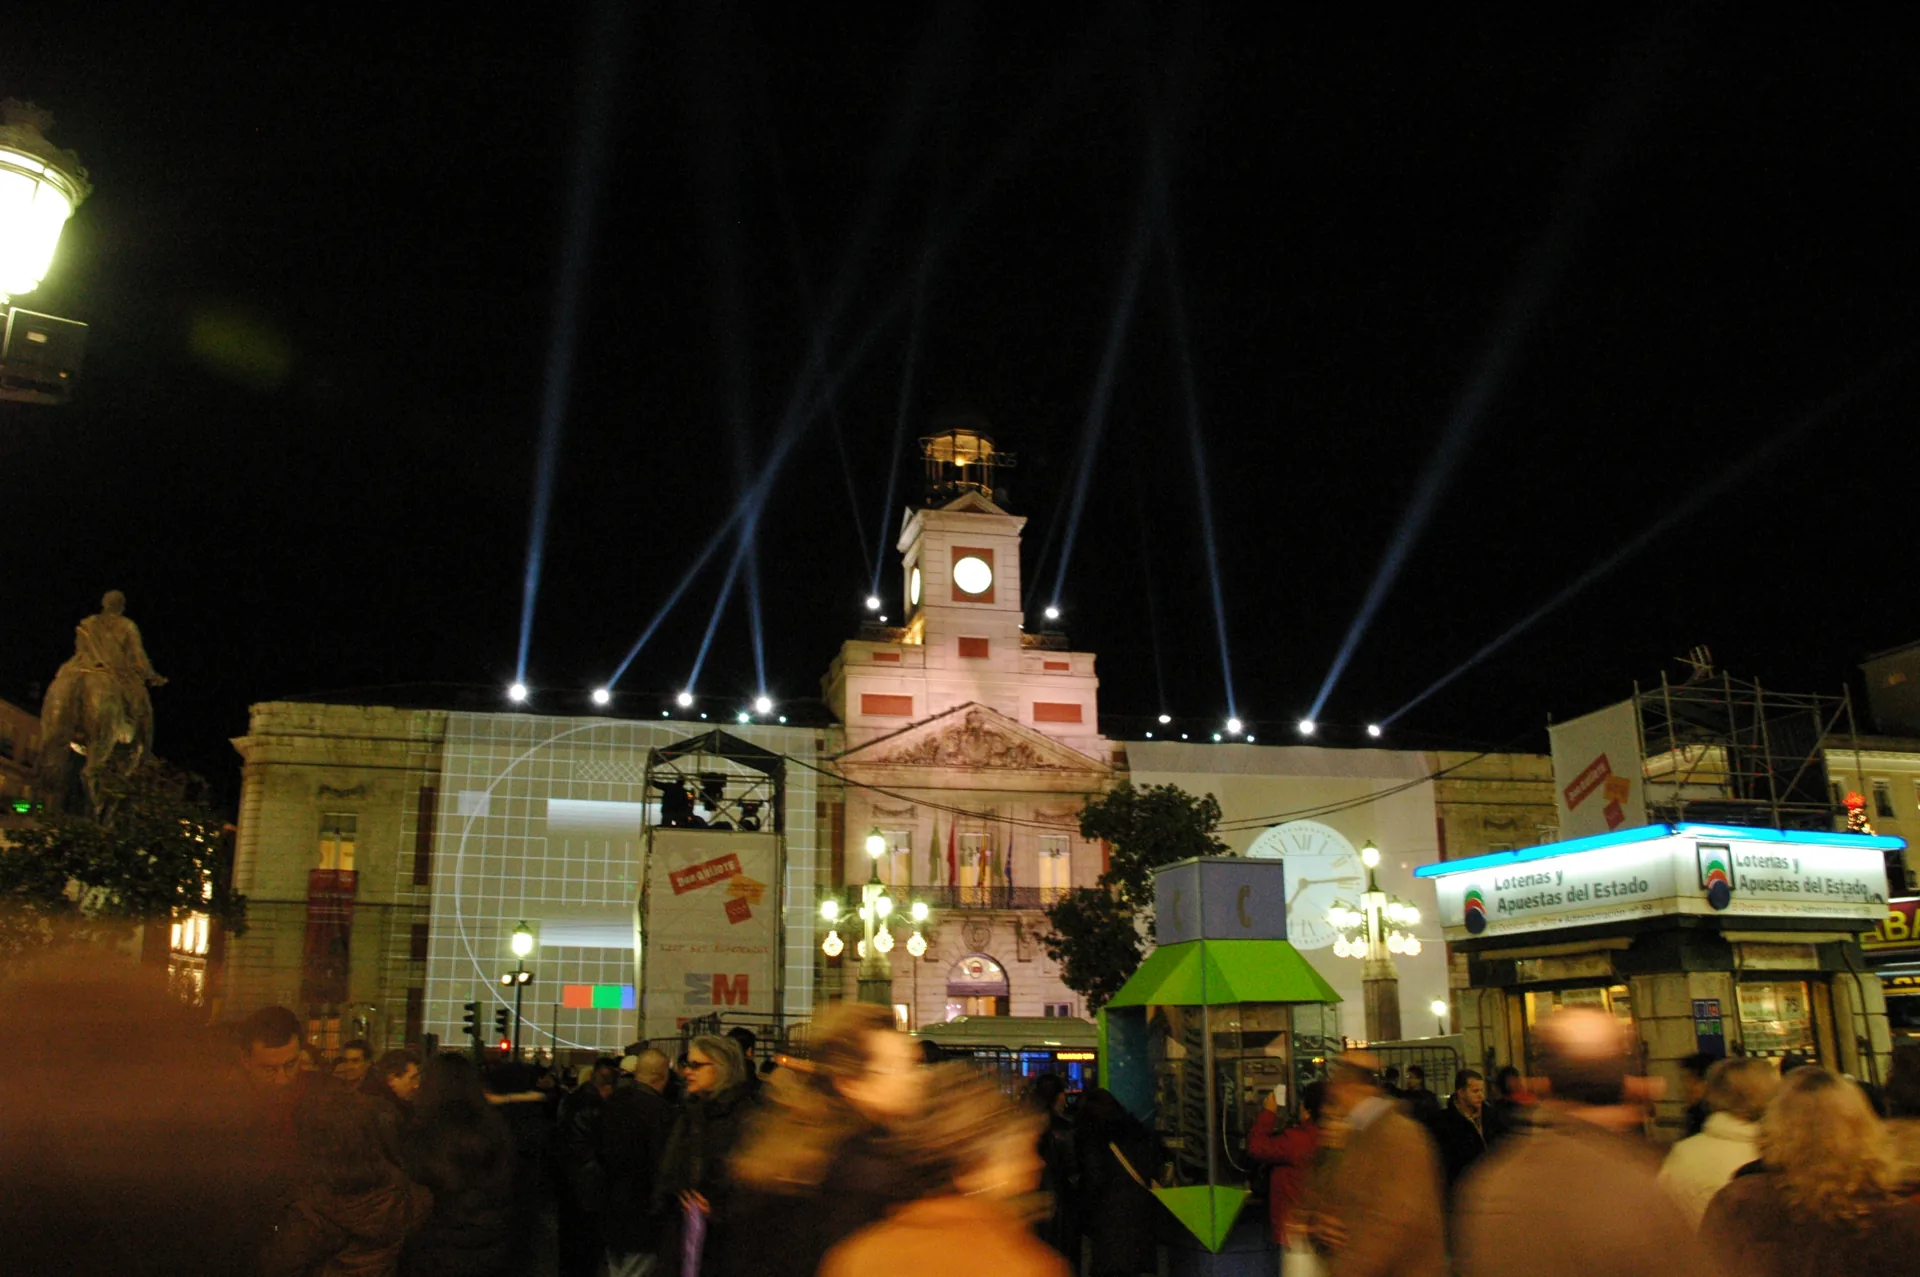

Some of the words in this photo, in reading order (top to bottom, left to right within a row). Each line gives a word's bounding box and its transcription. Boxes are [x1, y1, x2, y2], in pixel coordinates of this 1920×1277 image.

[1792, 858, 1800, 874] y
[1555, 869, 1563, 887] y
[1739, 874, 1800, 896] Apuestas
[1803, 876, 1823, 894] del
[1825, 877, 1868, 896] Estado
[1497, 891, 1562, 916] Apuestas
[1567, 884, 1589, 903] del
[1594, 876, 1649, 899] Estado
